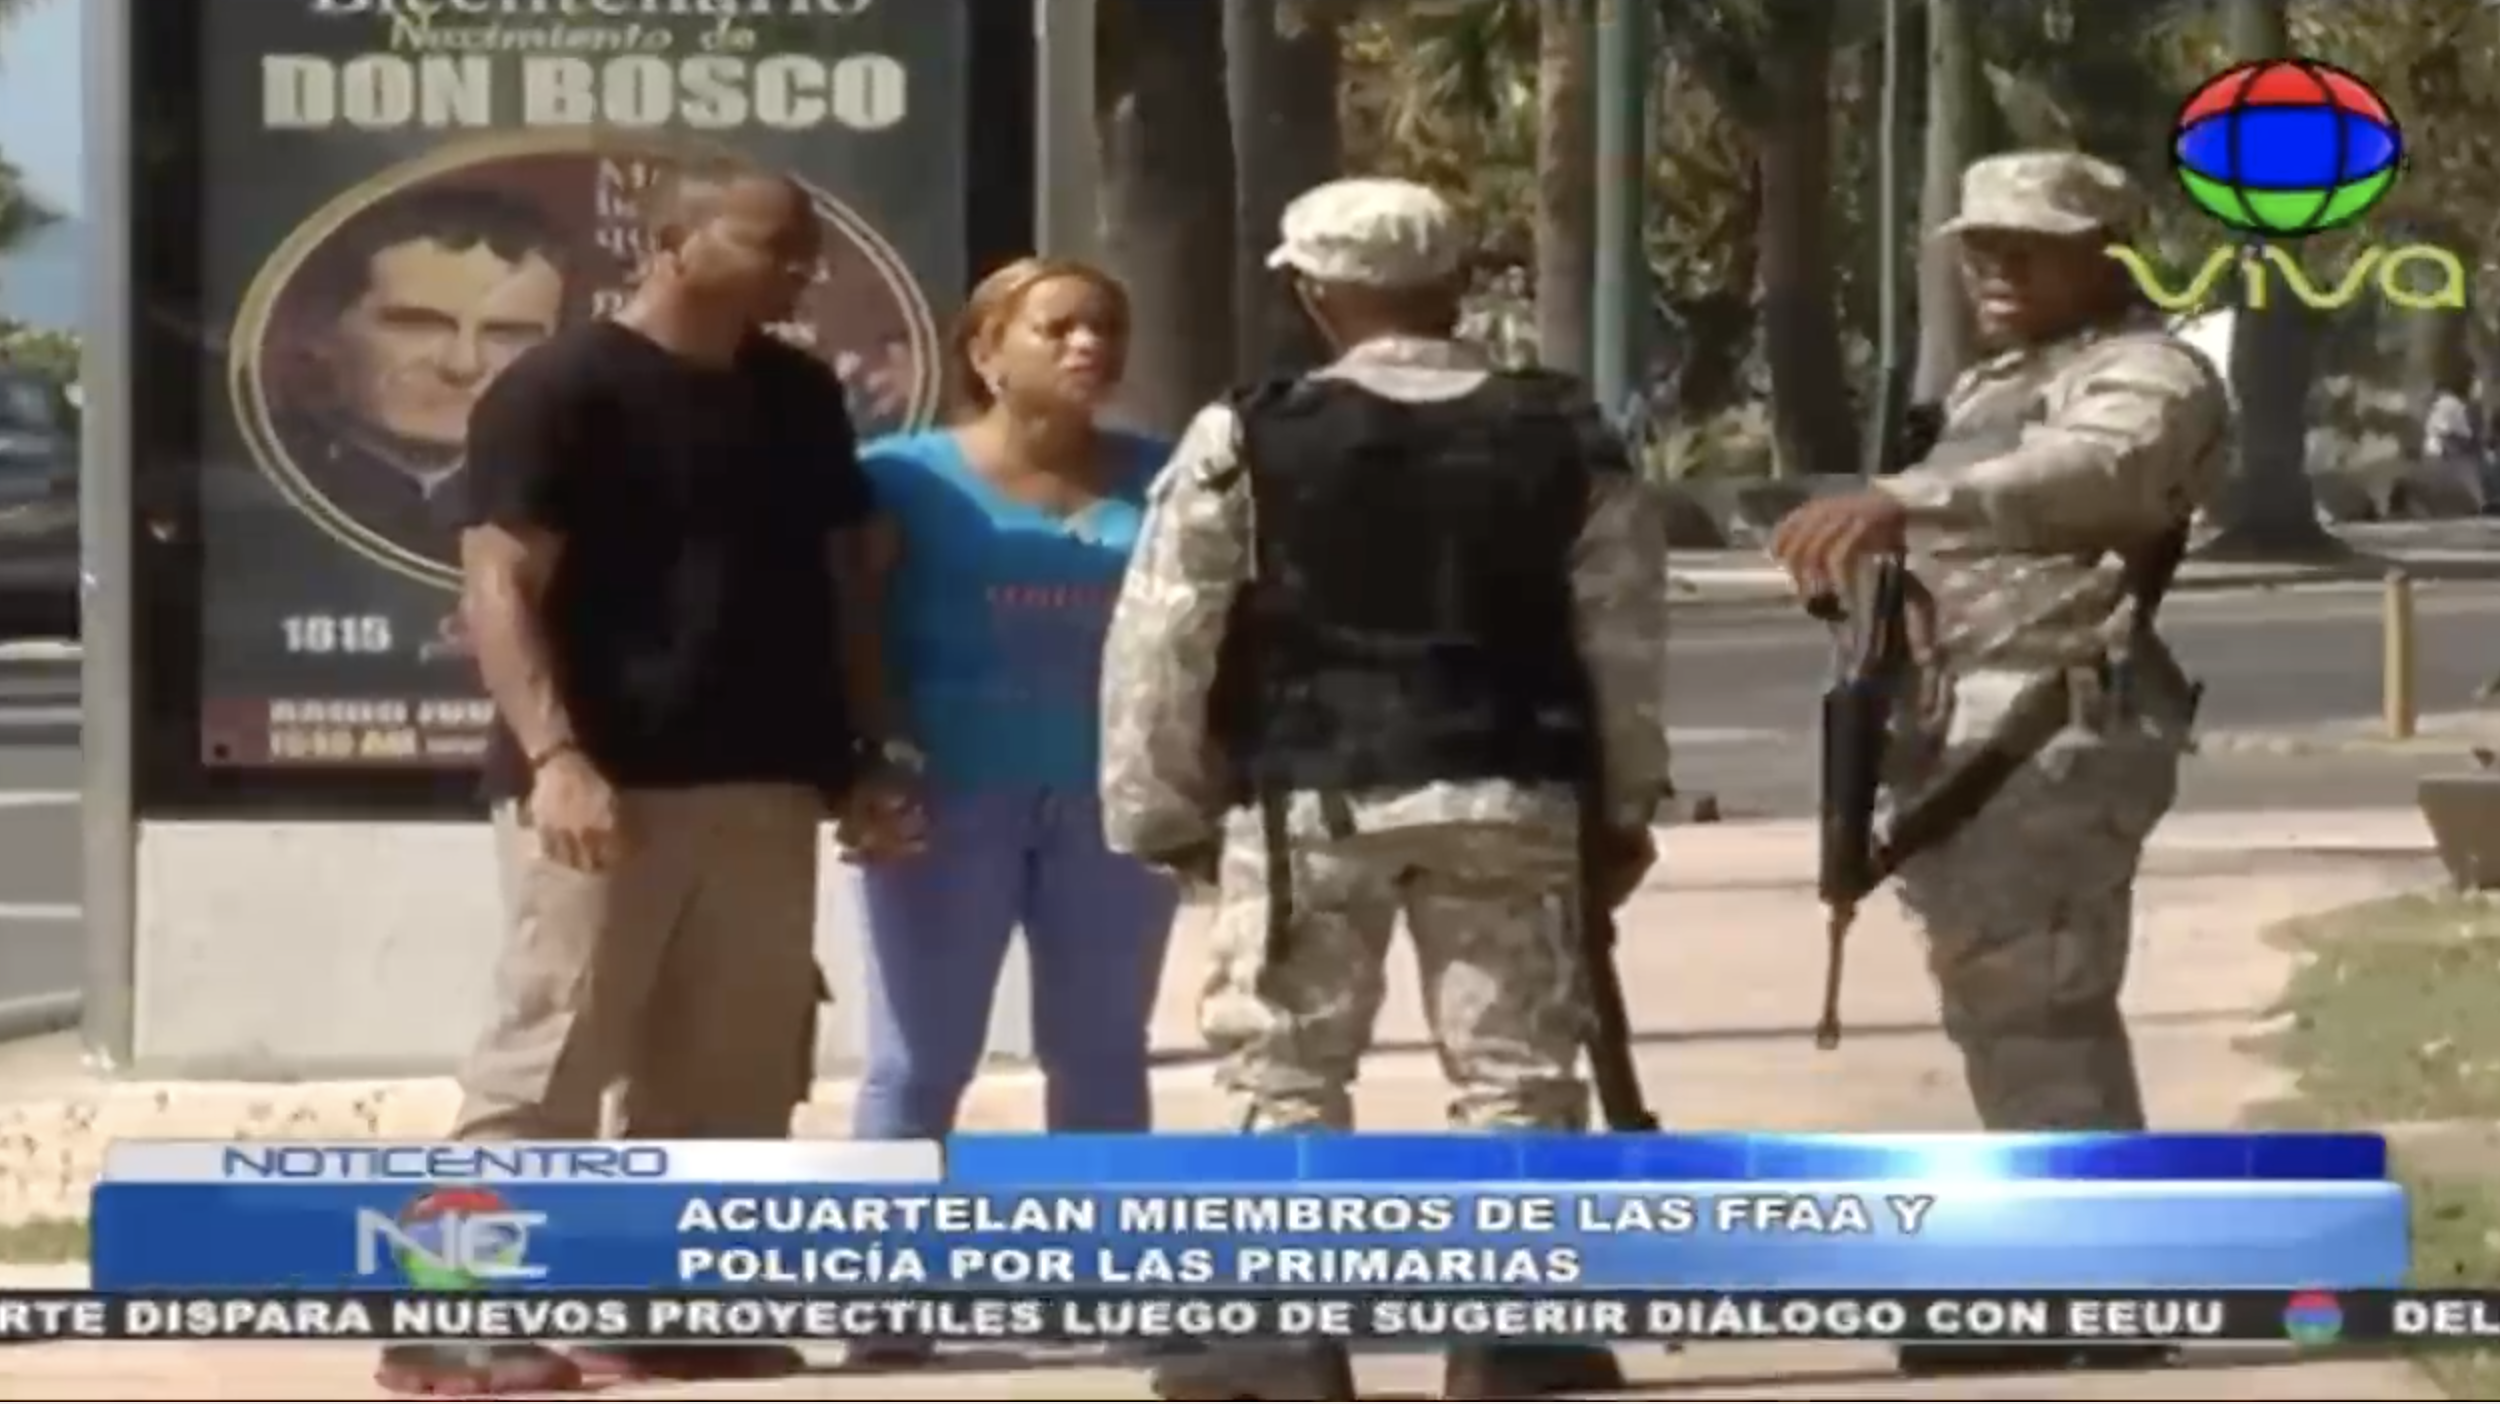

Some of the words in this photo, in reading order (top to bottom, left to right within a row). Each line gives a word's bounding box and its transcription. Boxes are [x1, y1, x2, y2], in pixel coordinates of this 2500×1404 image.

[700, 16, 757, 51] de
[262, 54, 492, 130] DON
[523, 53, 907, 131] BOSCO
